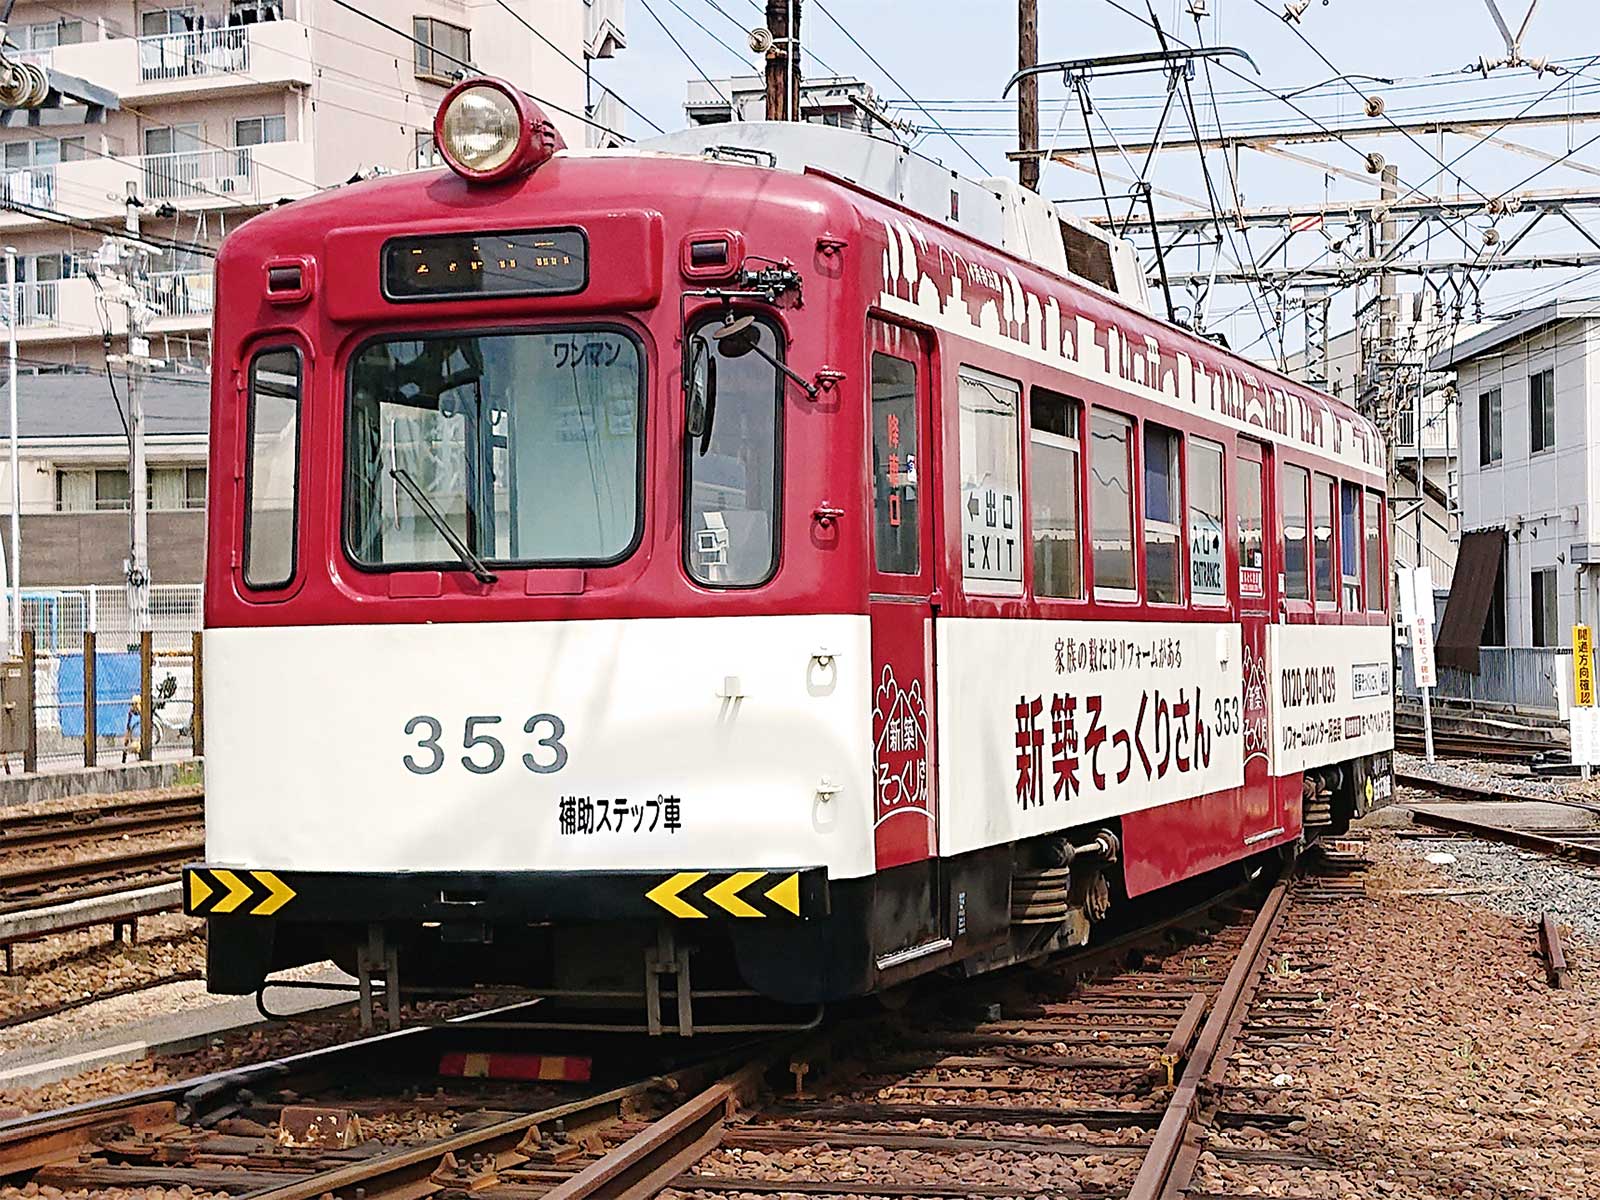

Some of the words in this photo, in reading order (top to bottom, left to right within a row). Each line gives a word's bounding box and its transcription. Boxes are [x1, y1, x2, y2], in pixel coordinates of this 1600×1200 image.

[555, 341, 621, 368] ワンマン
[985, 489, 1014, 530] 出口
[966, 533, 1015, 573] EXIT
[1192, 525, 1210, 555] 入口
[1192, 560, 1221, 590] ENTRANCE
[1055, 637, 1182, 675] 家族の数だけリフォームがある
[889, 716, 916, 752] 新築
[1214, 697, 1240, 738] 353
[403, 713, 568, 774] 353
[1015, 686, 1211, 811] 新築そっくりさん
[558, 794, 682, 835] 補助ステップ車
